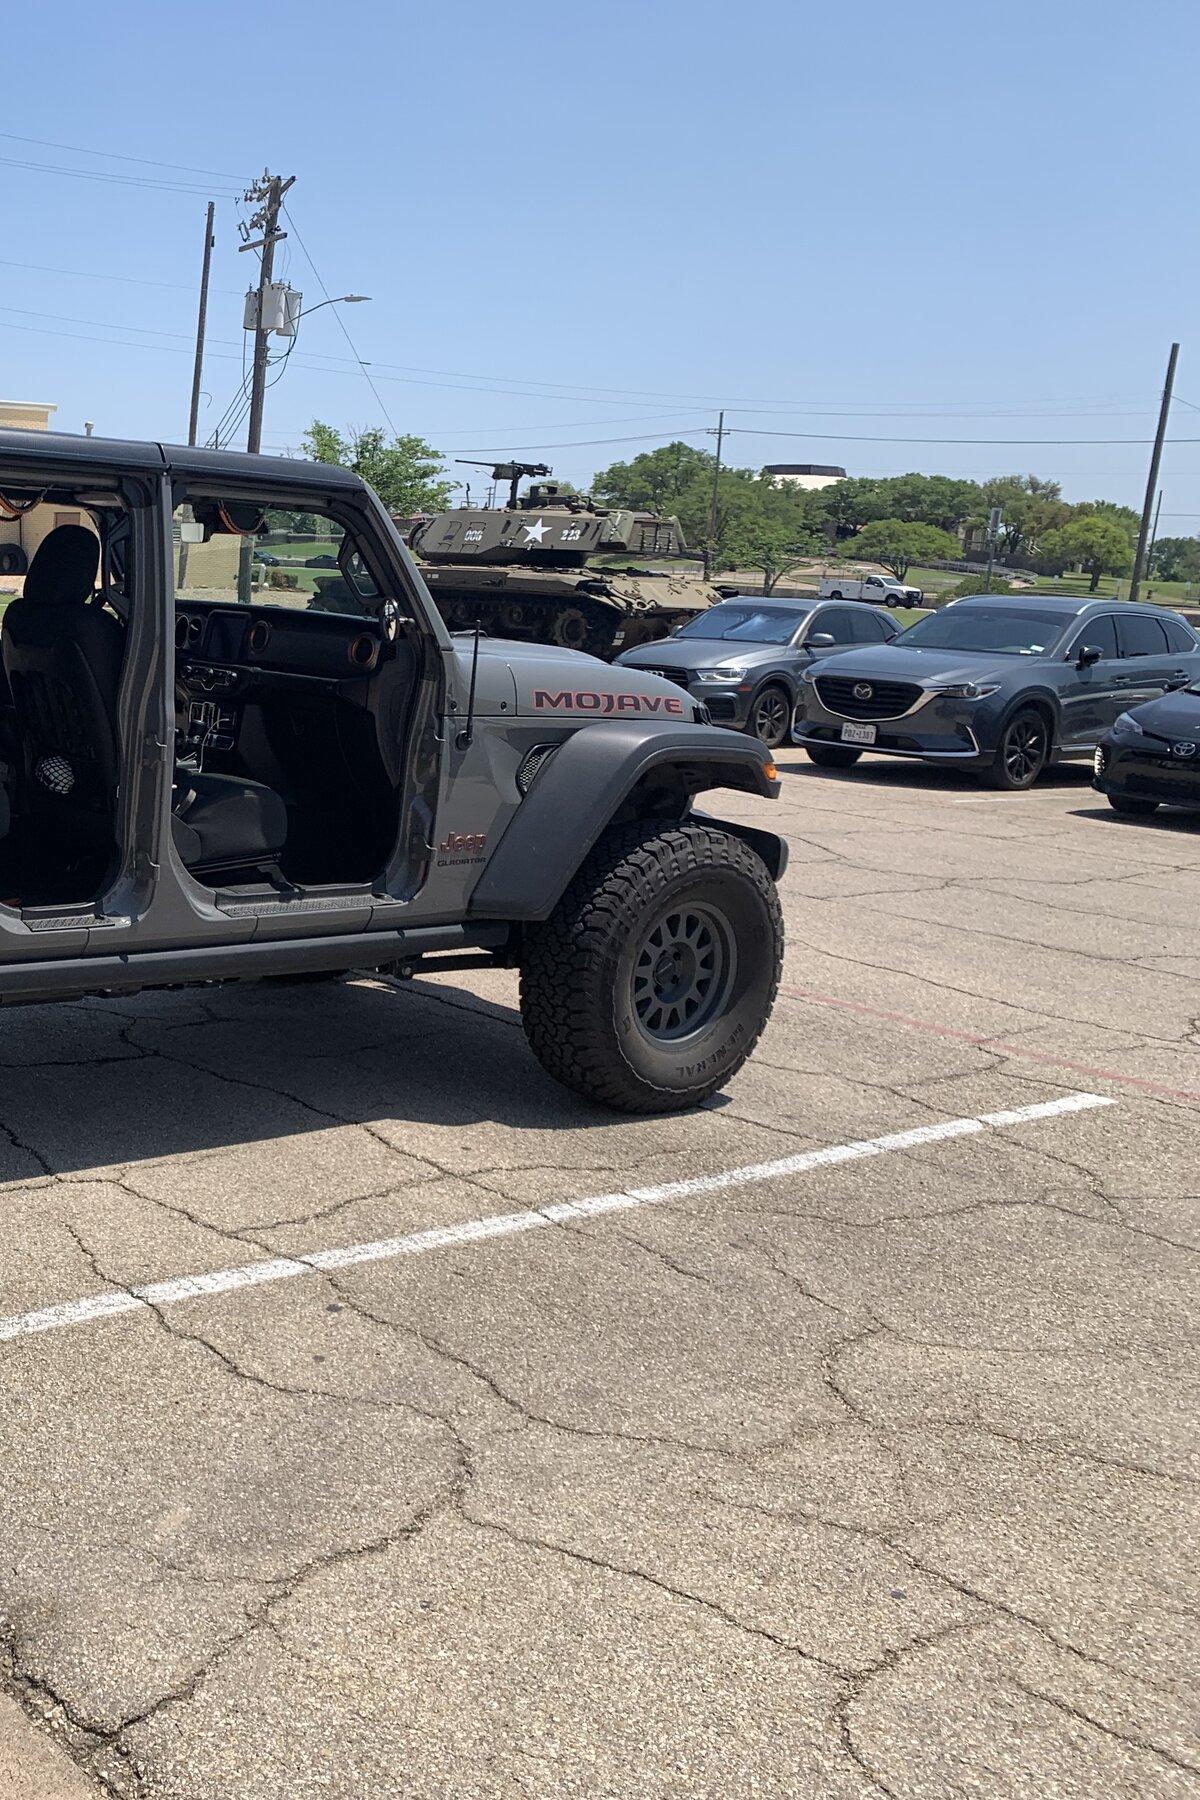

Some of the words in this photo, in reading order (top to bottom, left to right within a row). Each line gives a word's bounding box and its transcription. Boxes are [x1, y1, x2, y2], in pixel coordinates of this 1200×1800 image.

[560, 529, 581, 541] 223
[533, 689, 685, 715] MOJAVE
[440, 831, 487, 854] Jeep
[437, 857, 487, 867] GLADIATOR
